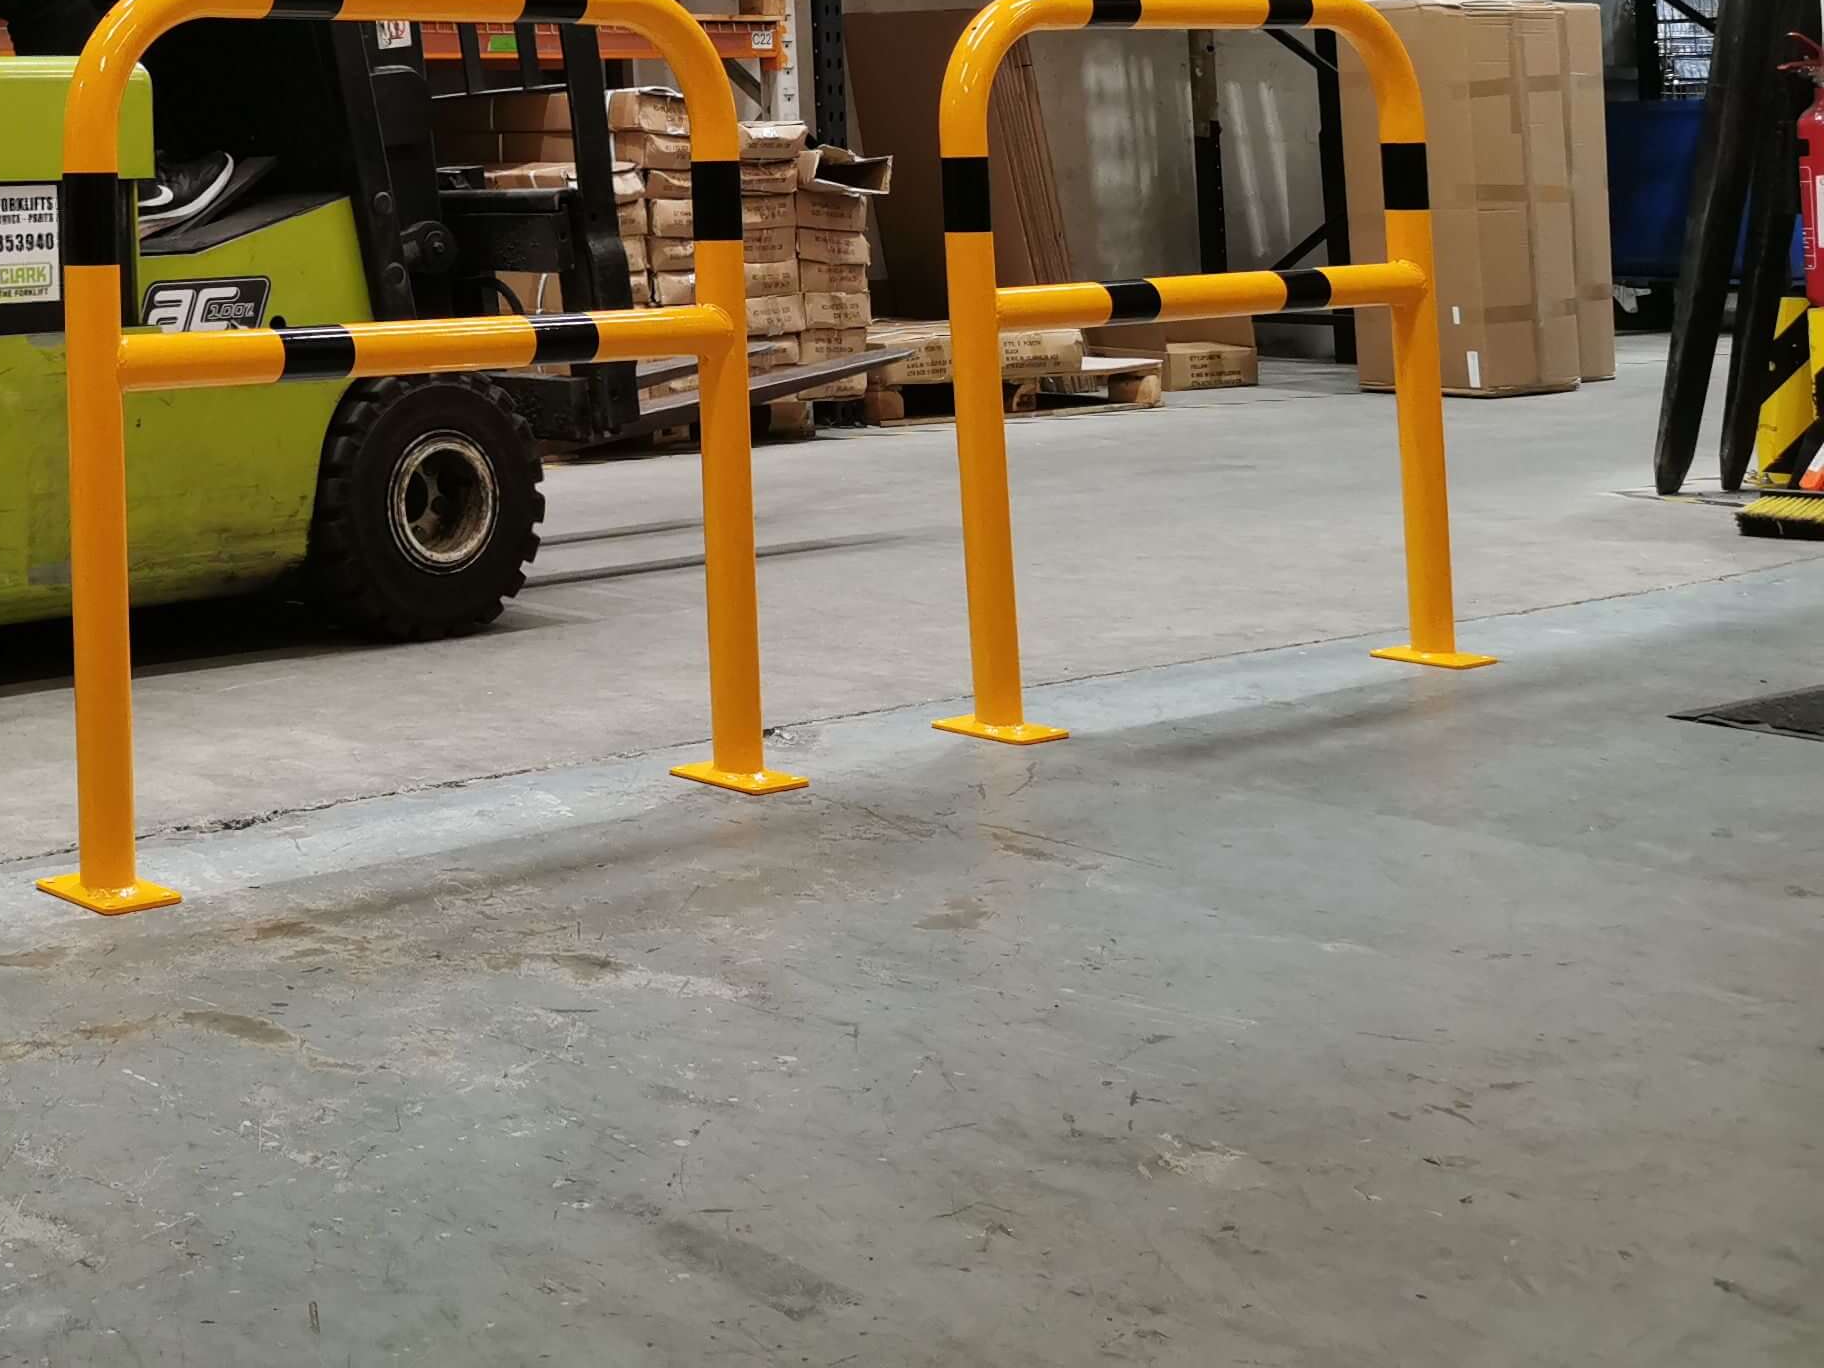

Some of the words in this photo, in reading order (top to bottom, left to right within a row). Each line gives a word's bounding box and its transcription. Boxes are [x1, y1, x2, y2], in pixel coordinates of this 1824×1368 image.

[752, 33, 772, 46] C22
[28, 213, 54, 224] PARTS
[14, 287, 49, 298] FORKLIFT
